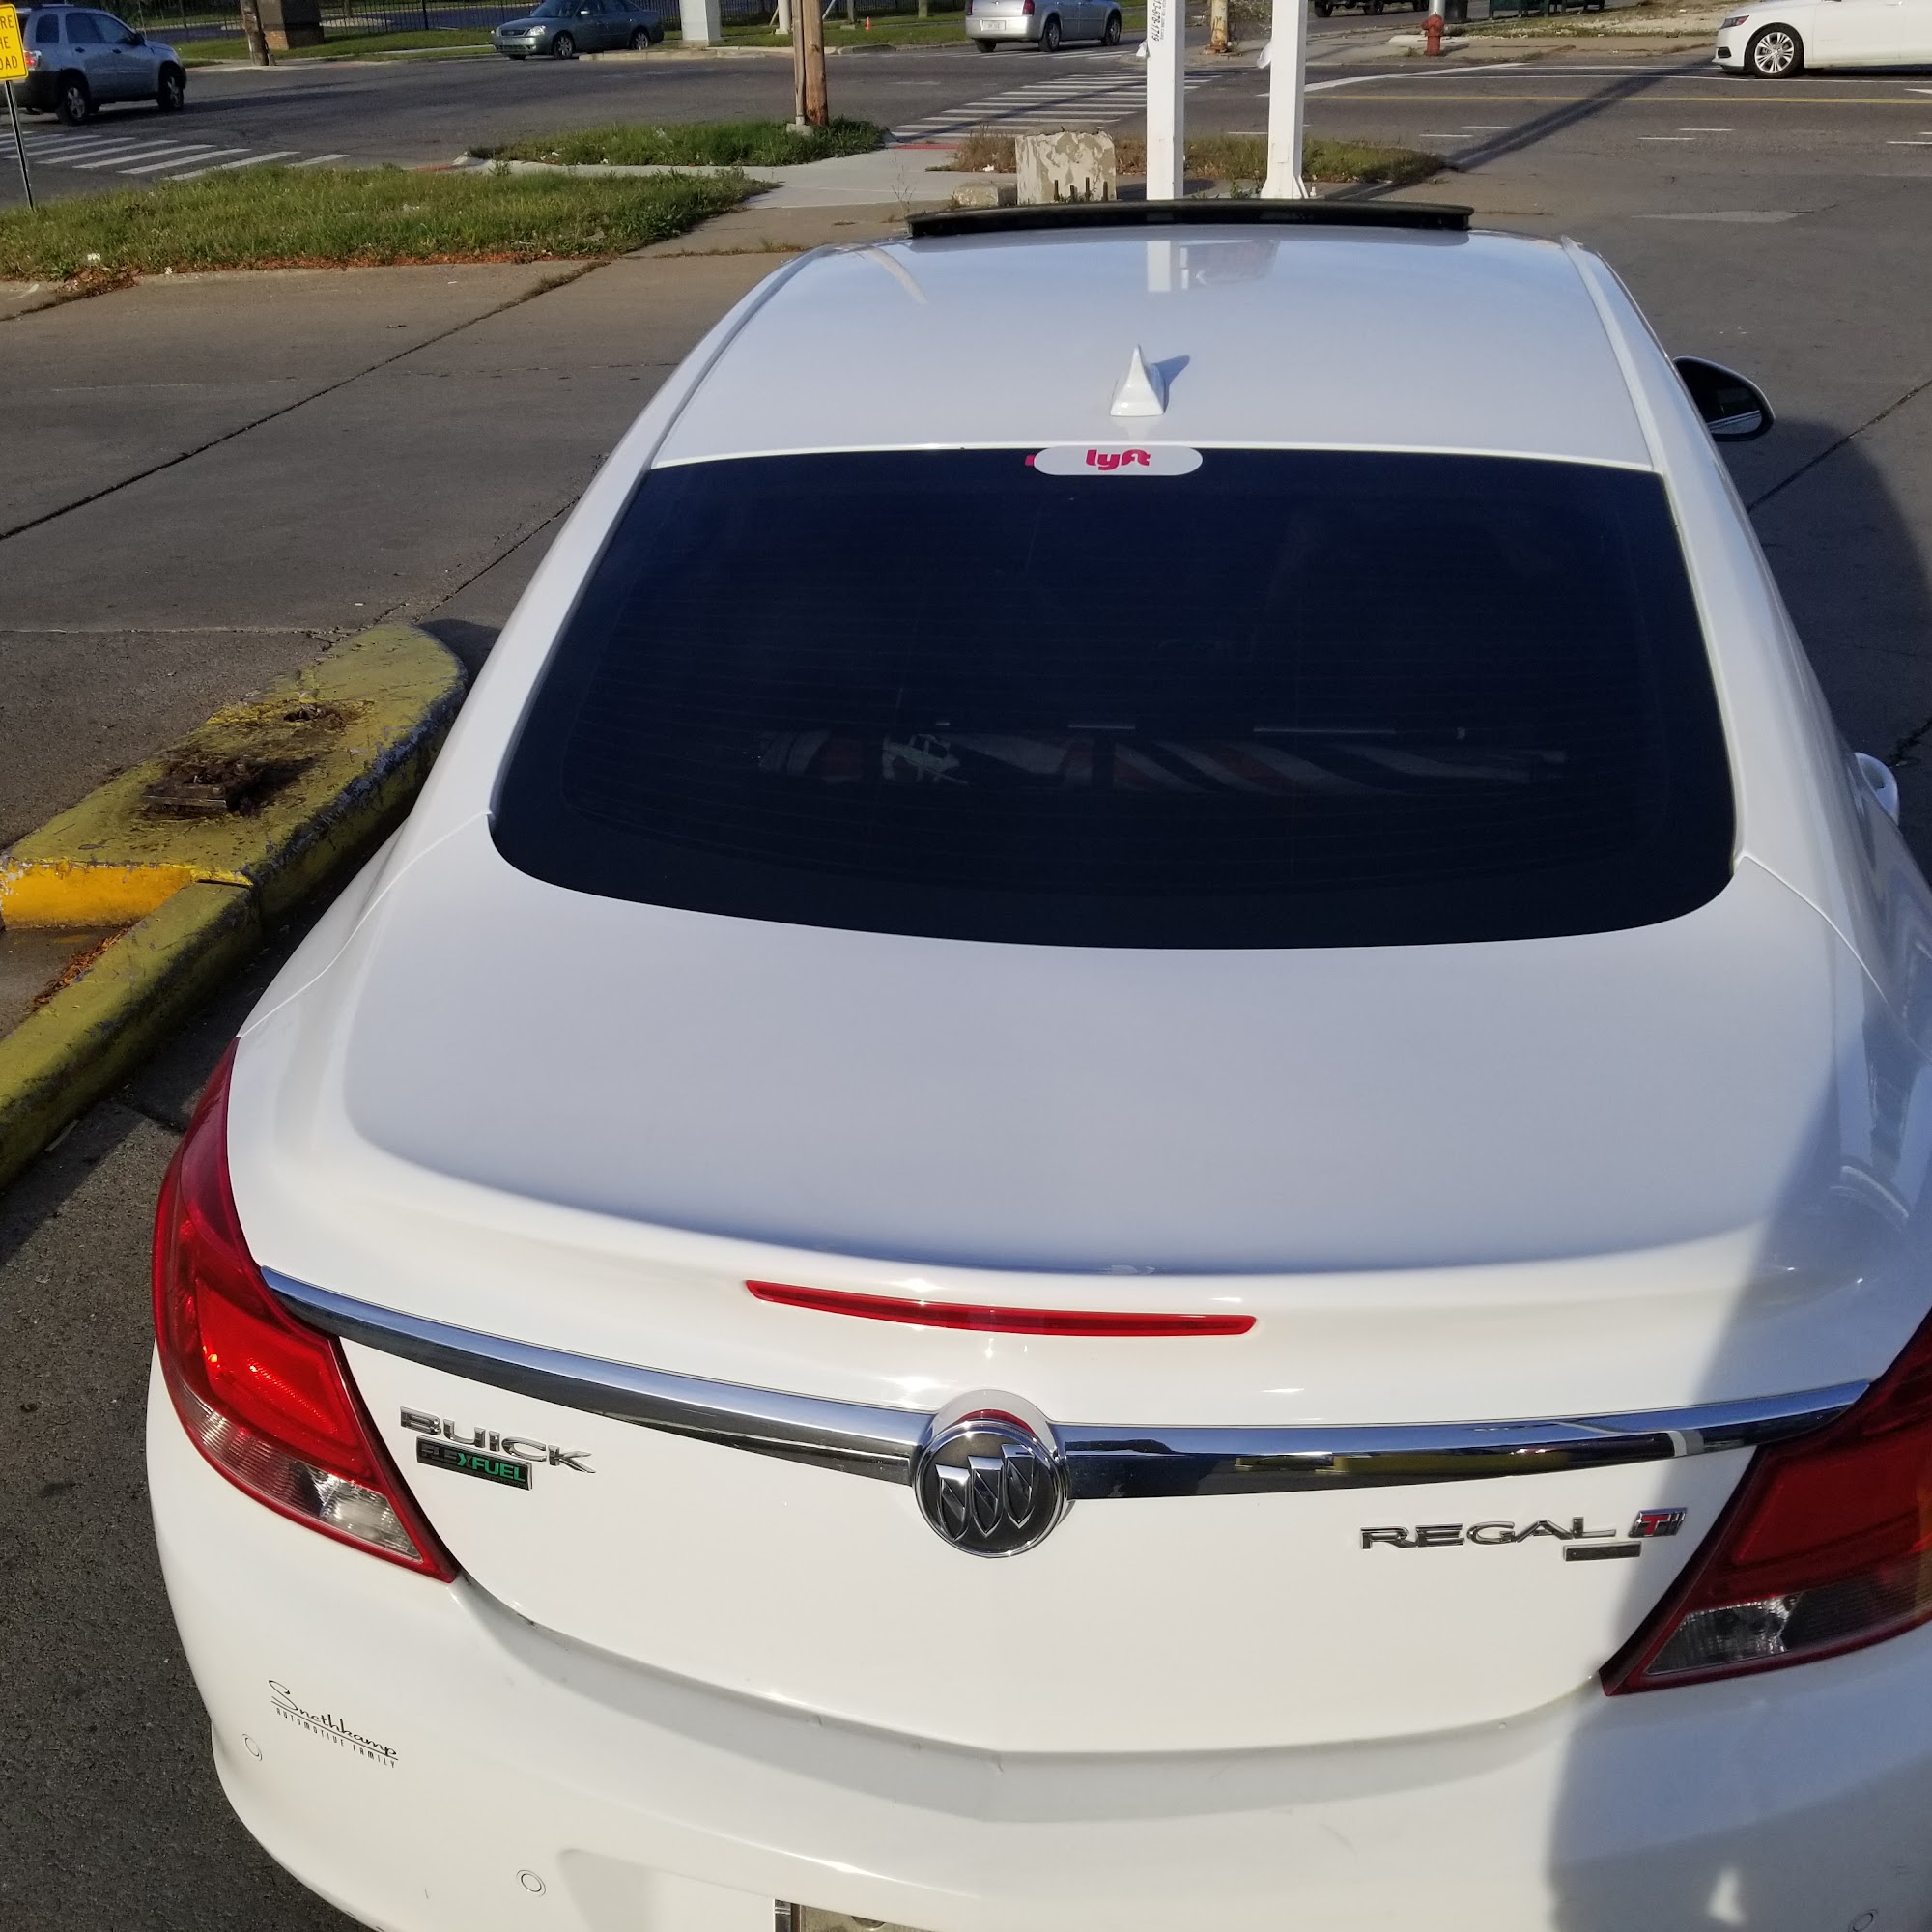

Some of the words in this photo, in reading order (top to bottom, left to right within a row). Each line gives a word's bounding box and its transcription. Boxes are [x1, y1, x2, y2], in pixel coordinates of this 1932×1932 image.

[1085, 448, 1151, 471] lyft
[399, 1406, 597, 1474] BUICK
[1360, 1516, 1617, 1550] REGAL
[276, 1707, 345, 1747] AUTOMOTIVE
[352, 1743, 395, 1769] FAMILY
